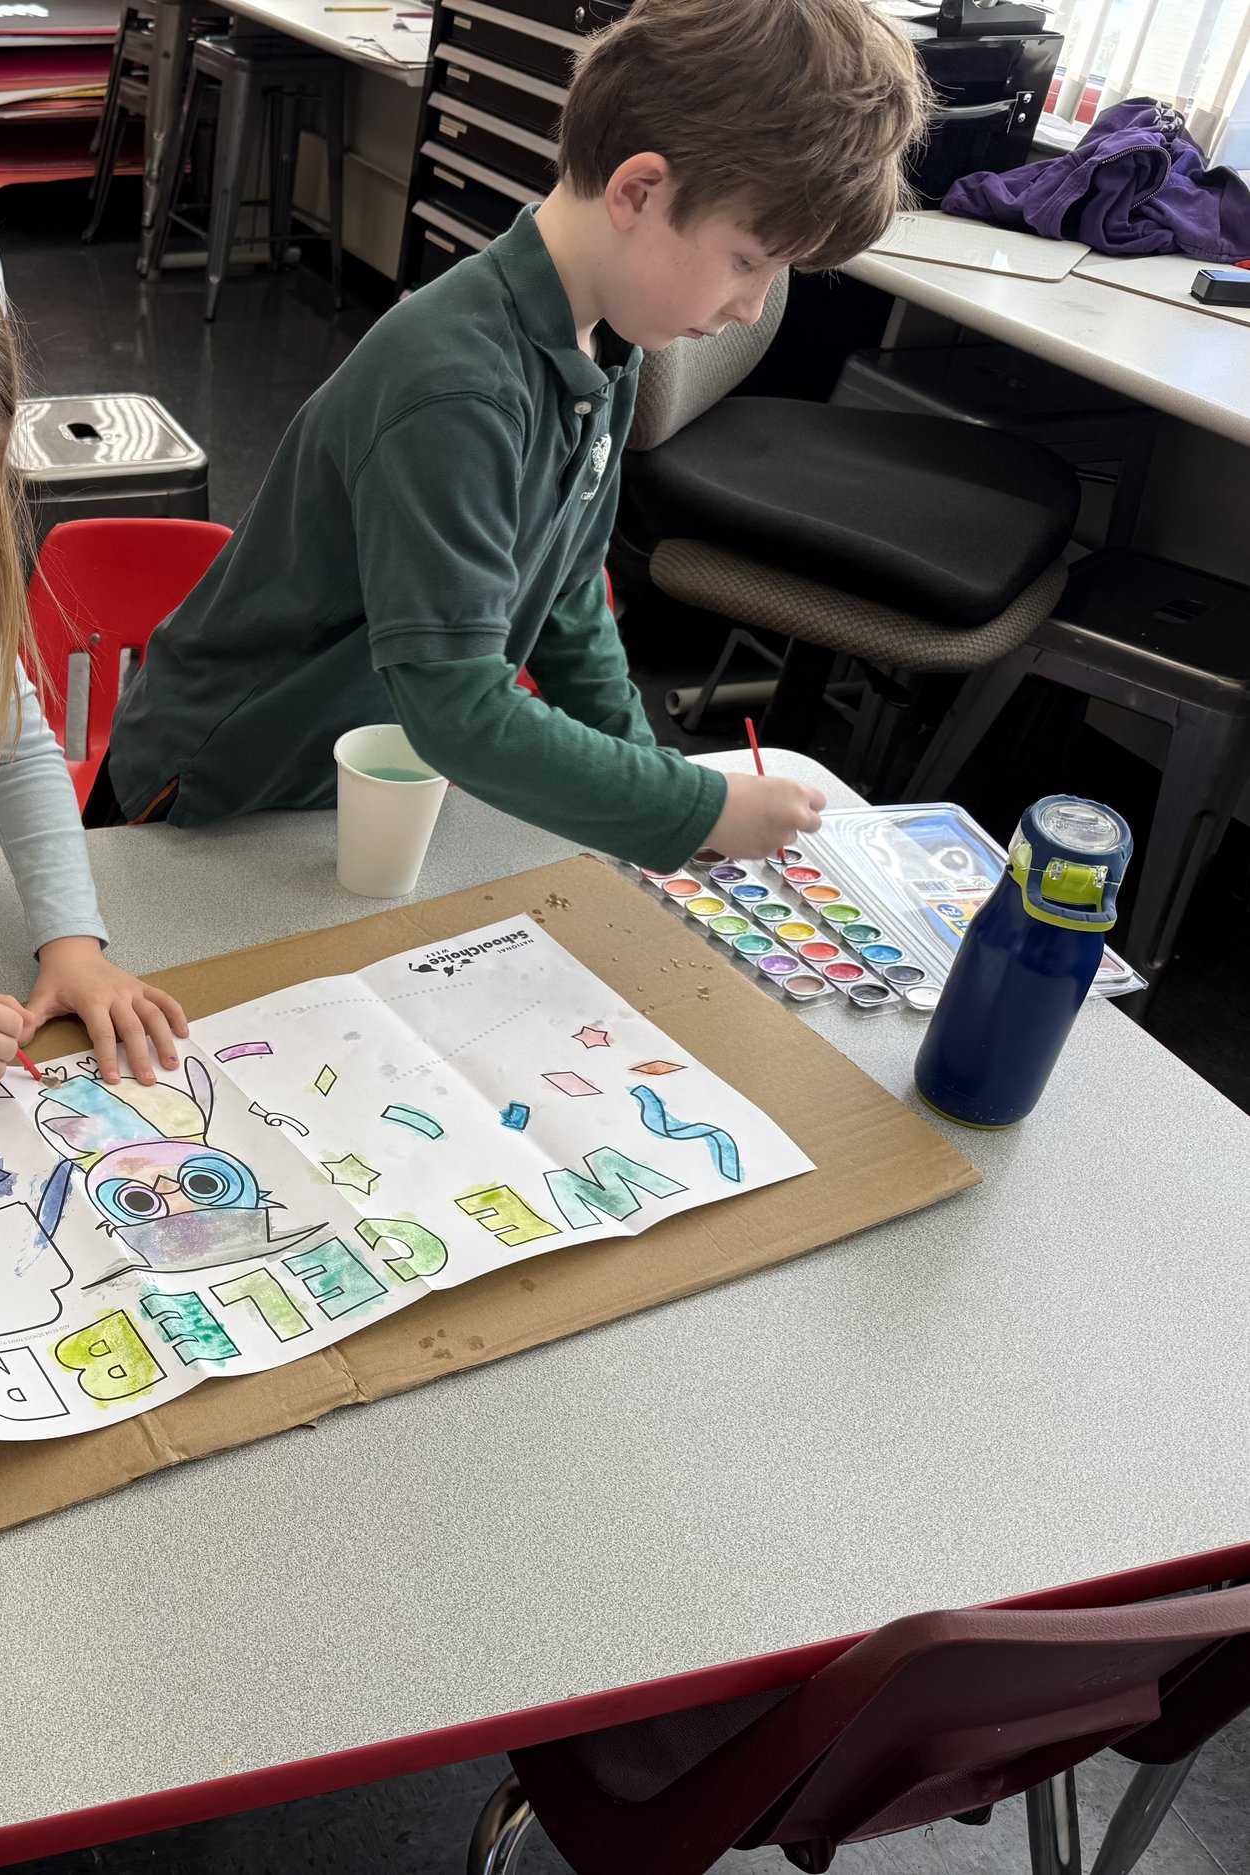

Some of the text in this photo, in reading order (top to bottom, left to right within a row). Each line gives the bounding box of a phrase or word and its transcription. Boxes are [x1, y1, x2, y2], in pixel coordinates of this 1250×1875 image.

[424, 948, 449, 959] WEEK
[428, 930, 529, 966] SchoolChoice
[496, 938, 534, 954] NATIONAL
[454, 1147, 687, 1247] WE
